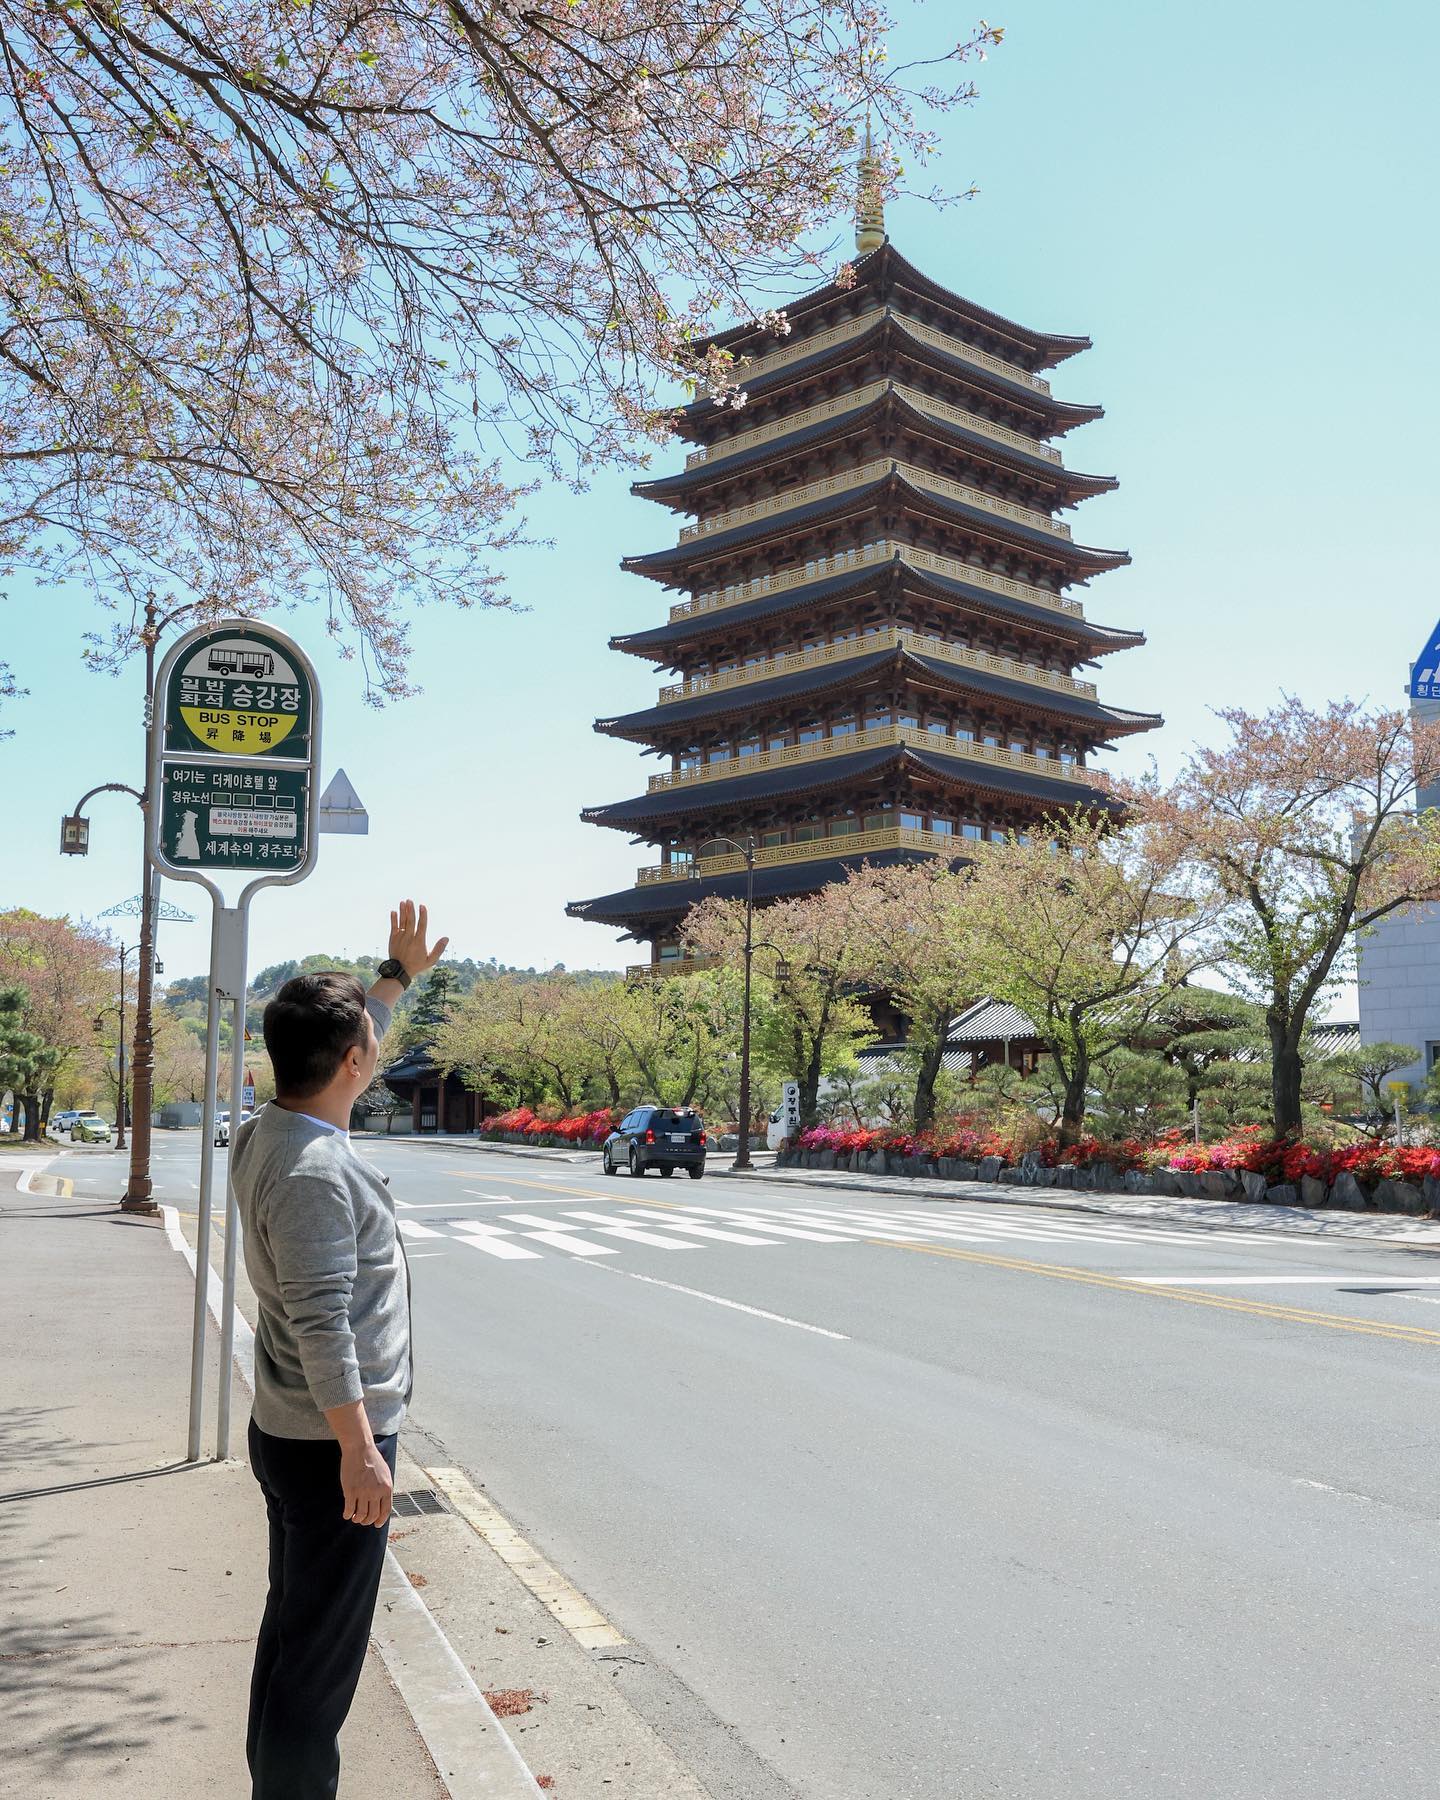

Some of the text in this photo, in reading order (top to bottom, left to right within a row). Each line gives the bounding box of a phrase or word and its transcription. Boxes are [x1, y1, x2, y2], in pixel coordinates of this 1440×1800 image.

[180, 677, 227, 692] 일반
[179, 693, 224, 708] 좌석
[232, 683, 301, 711] 승강장
[199, 712, 279, 727] BUS STOP
[173, 770, 278, 791] 여기는 더케이호텔 앞
[172, 791, 210, 805] 경유노선
[204, 840, 298, 858] 세계속의 경주로!
